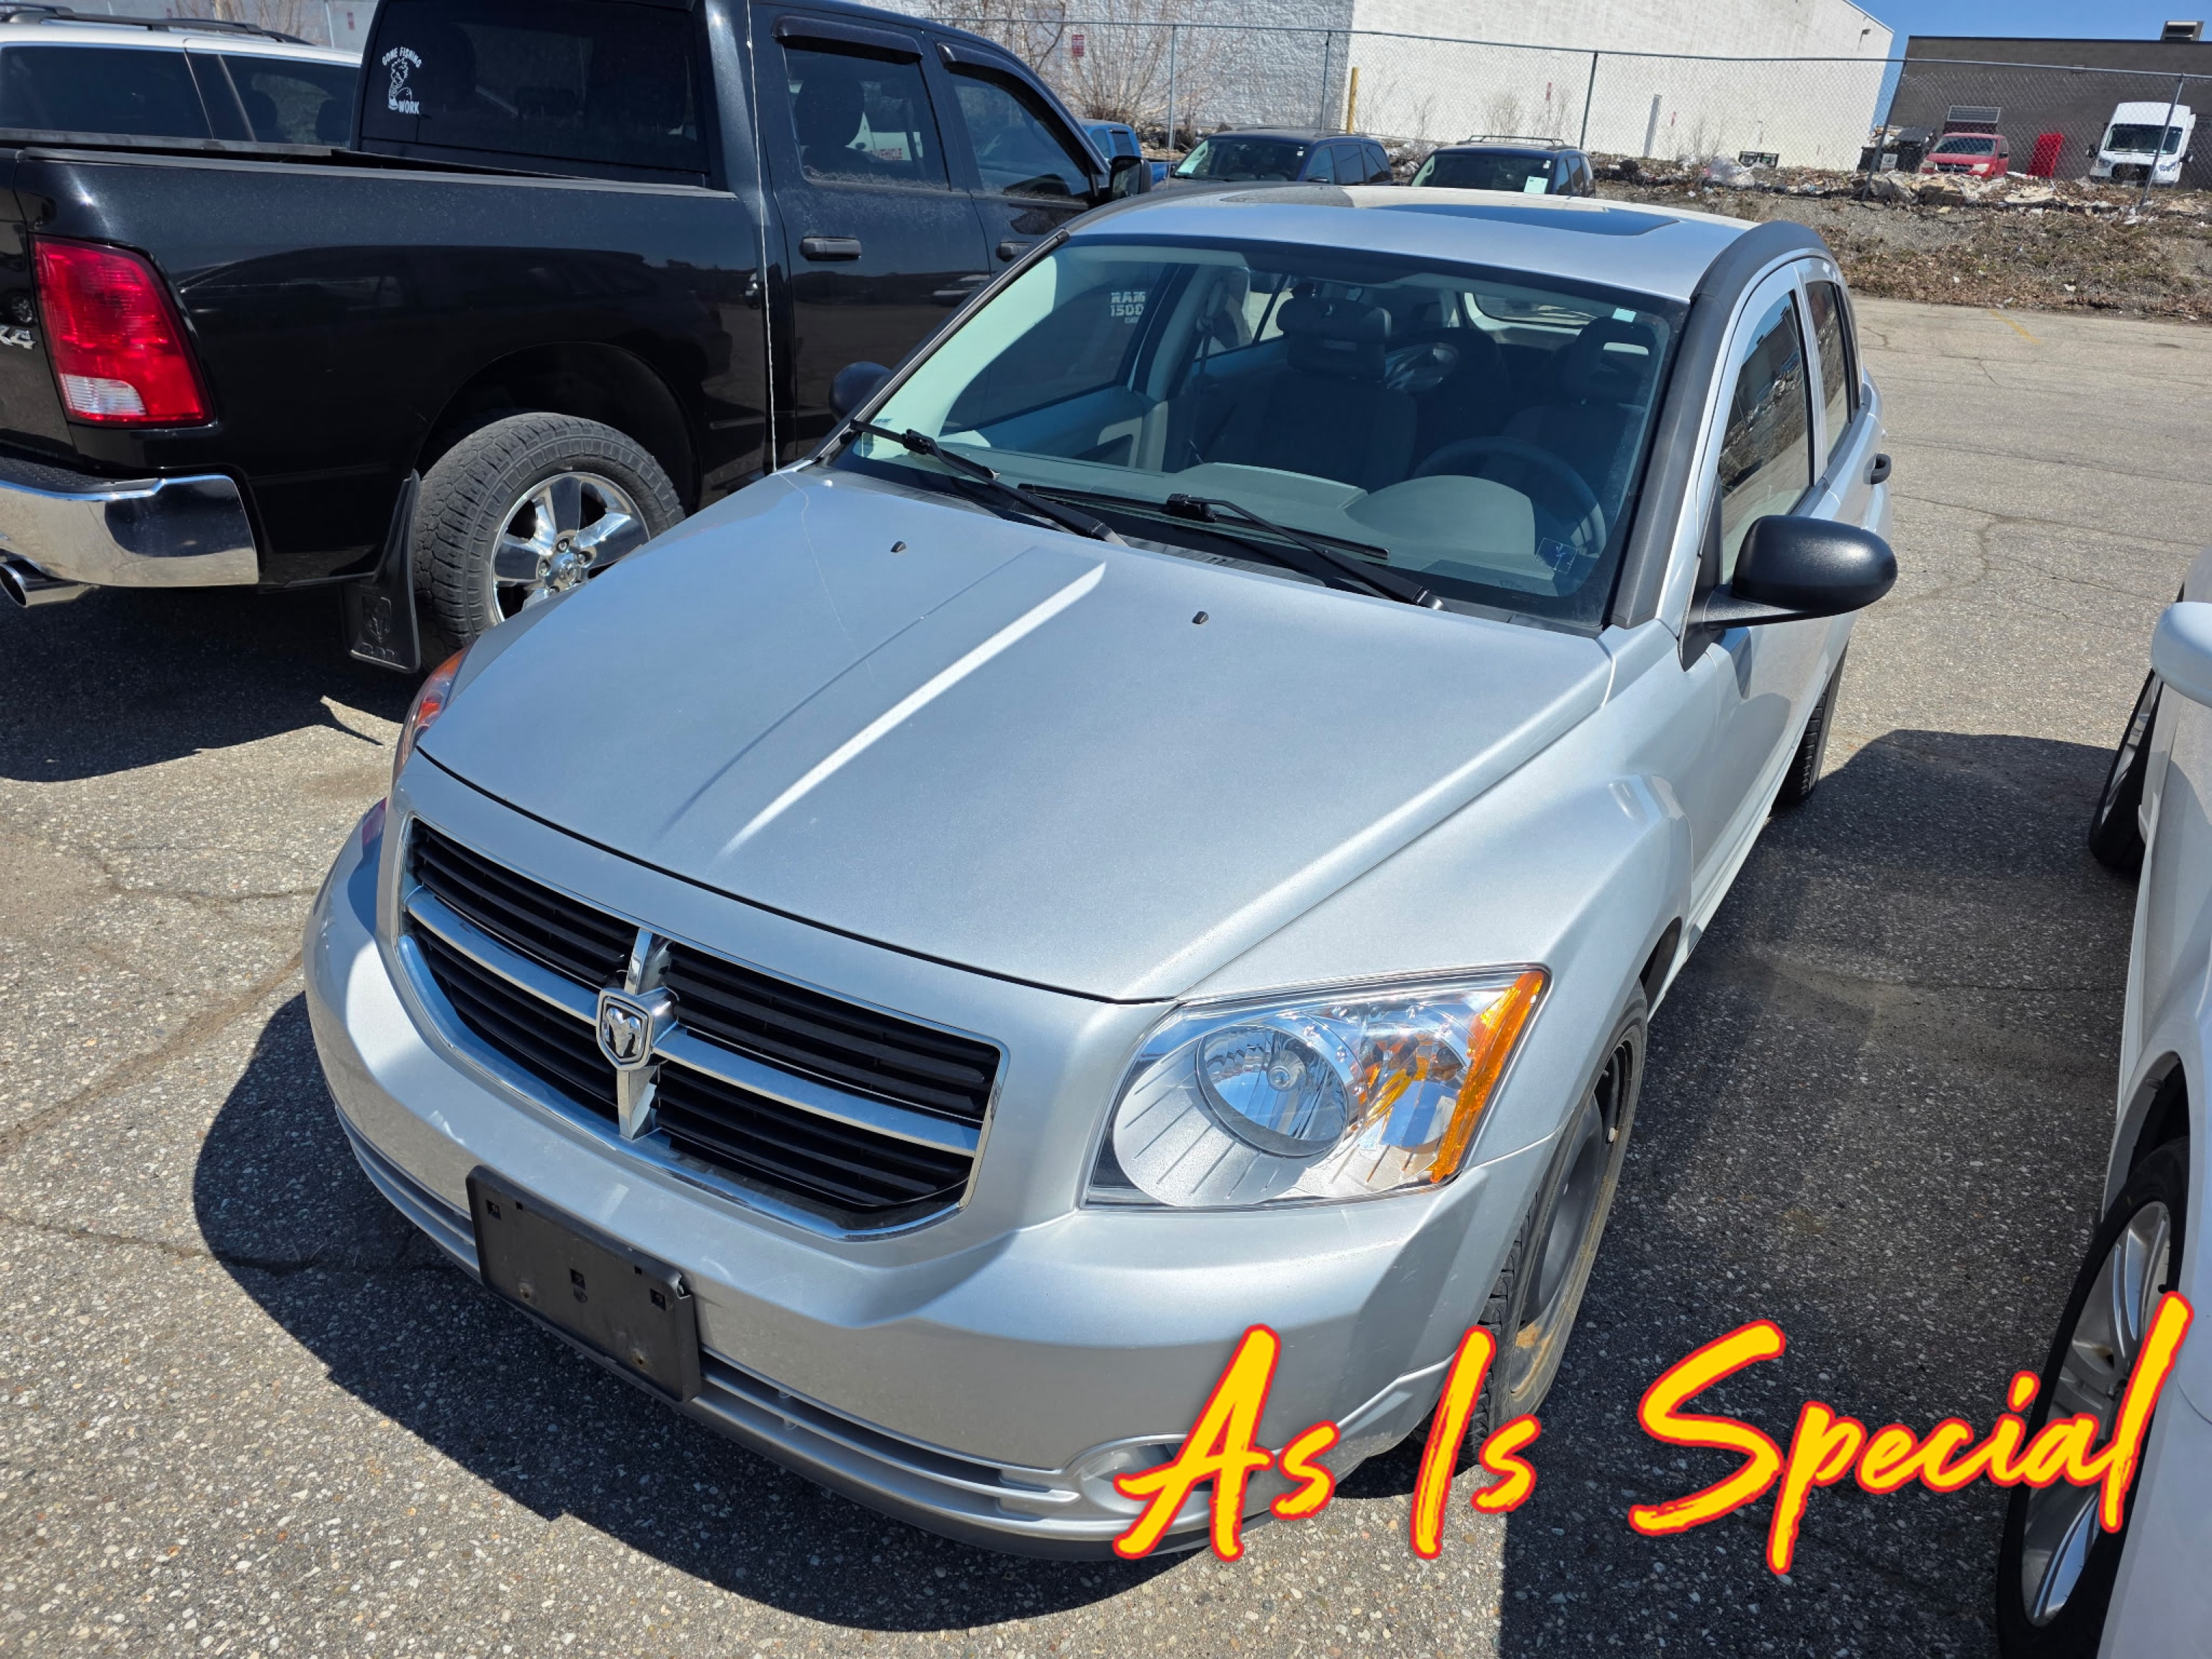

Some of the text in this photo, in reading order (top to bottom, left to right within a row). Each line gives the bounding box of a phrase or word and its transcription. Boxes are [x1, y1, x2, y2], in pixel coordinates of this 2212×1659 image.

[382, 48, 398, 66] GONE
[398, 99, 420, 114] WORK
[1111, 291, 1146, 302] RAM
[1110, 303, 1144, 316] 1500
